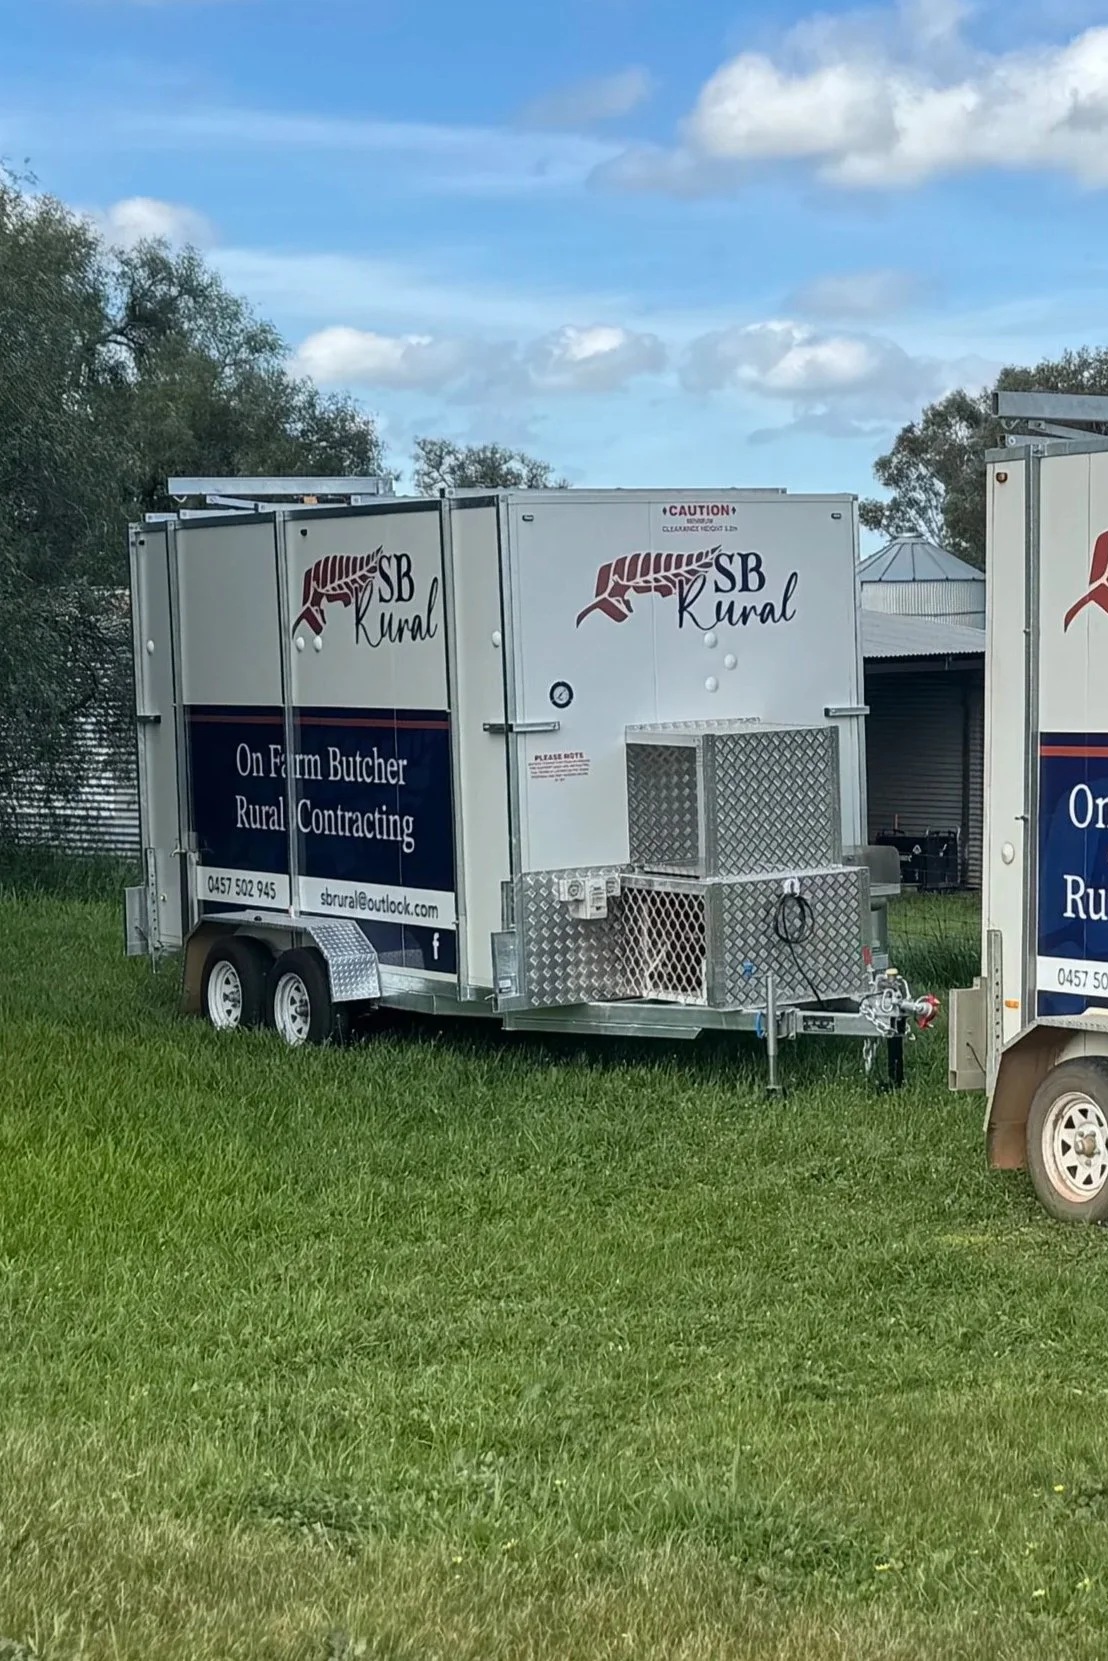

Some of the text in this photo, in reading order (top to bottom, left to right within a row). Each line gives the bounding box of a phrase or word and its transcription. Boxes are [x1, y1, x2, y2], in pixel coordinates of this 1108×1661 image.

[669, 504, 730, 516] CAUTION
[378, 553, 415, 603] SB
[713, 552, 766, 593] SB
[354, 576, 439, 648] Rural
[677, 571, 798, 631] Rural
[236, 743, 264, 777] On
[327, 746, 408, 785] Butcher
[534, 753, 562, 761] PLEASE
[235, 795, 415, 853] Rural Contracting
[207, 874, 276, 900] 0457 502 945
[320, 886, 439, 919] sbrural@outlook.com
[1057, 968, 1088, 988] 0457
